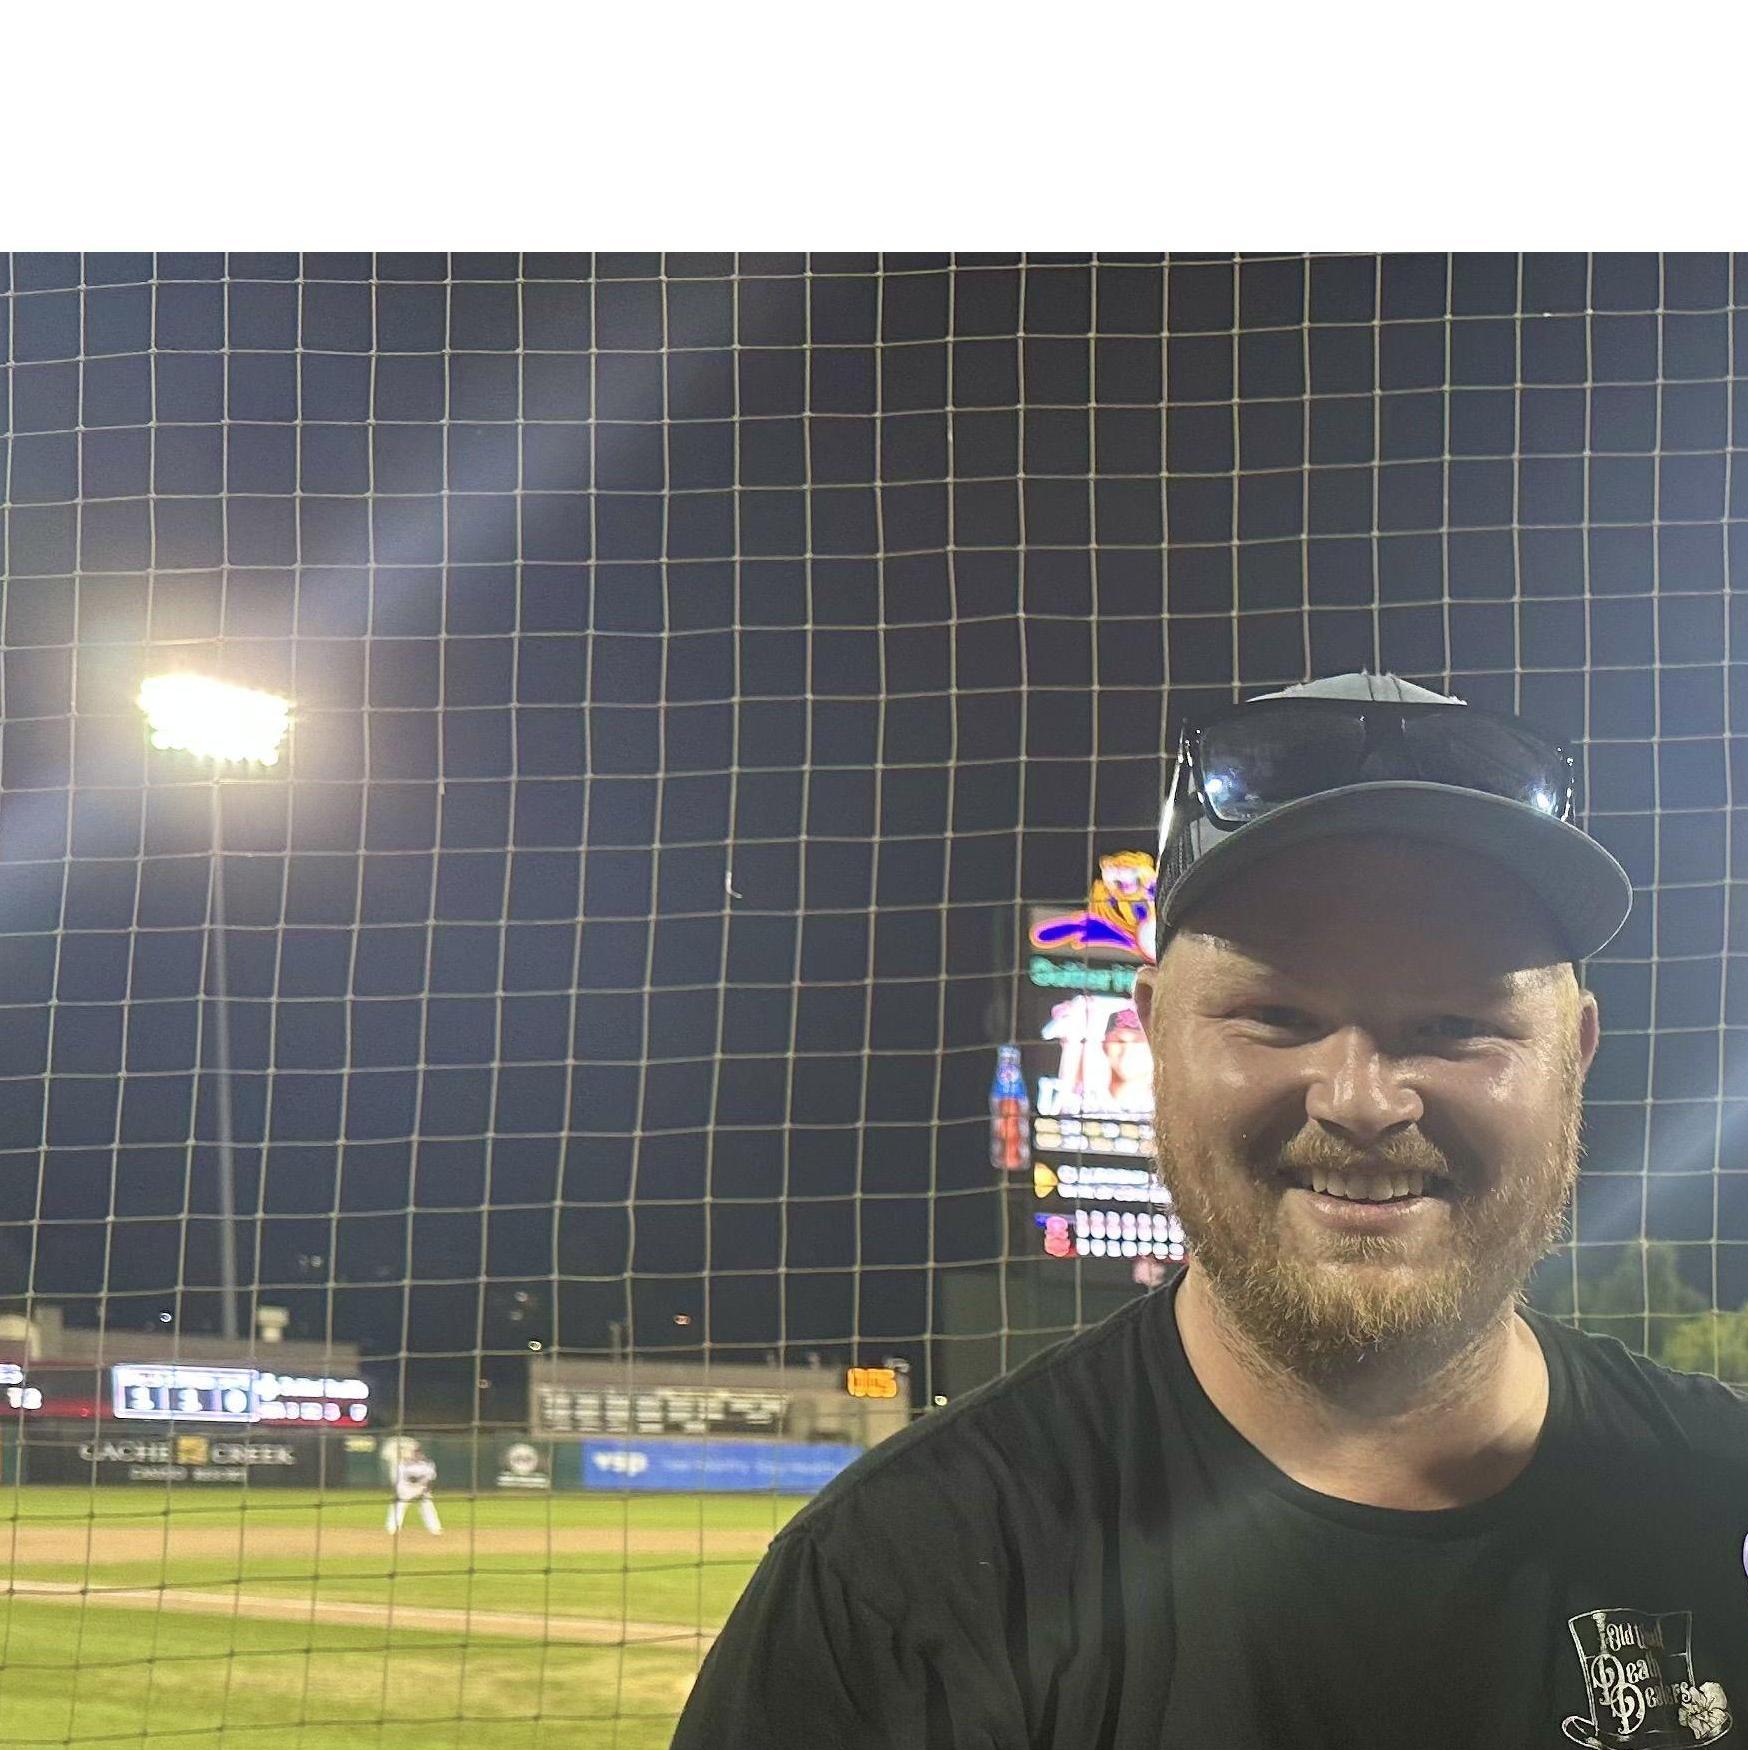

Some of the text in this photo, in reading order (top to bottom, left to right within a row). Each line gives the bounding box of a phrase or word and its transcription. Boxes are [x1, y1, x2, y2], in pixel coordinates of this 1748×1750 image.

[79, 1439, 297, 1465] CACHE CREEK
[1606, 1623, 1635, 1651] Old
